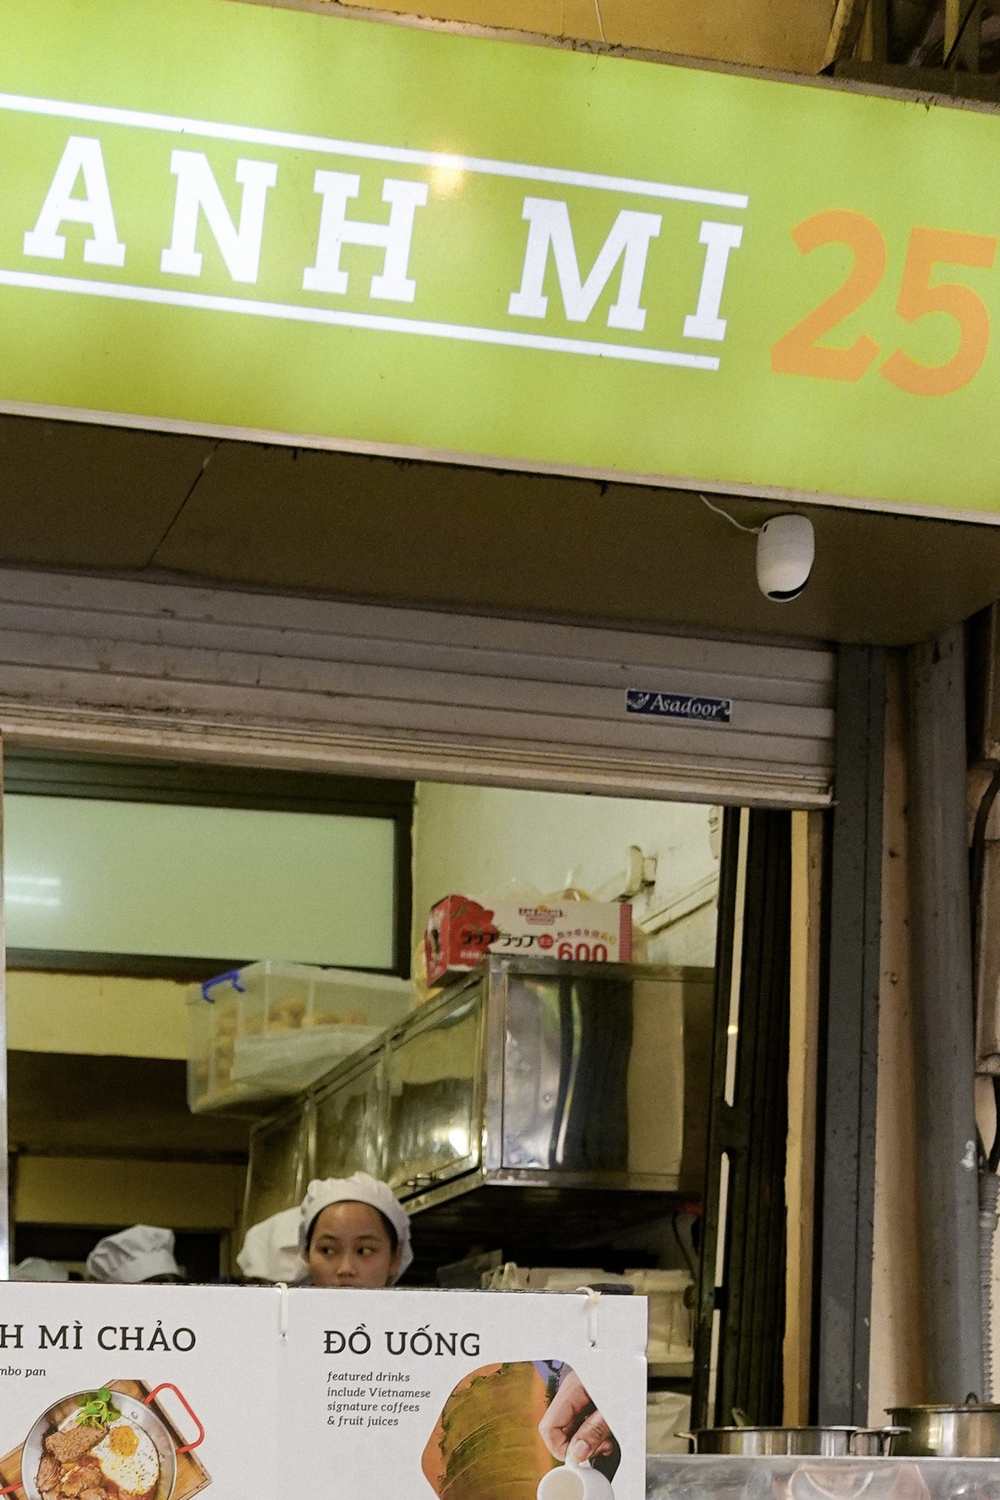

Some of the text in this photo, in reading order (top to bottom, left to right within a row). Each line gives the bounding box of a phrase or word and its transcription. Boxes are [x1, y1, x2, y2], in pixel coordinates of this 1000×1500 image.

[508, 196, 743, 341] MI
[769, 208, 997, 396] 25
[650, 695, 721, 716] Asadoor
[558, 942, 607, 961] 600
[38, 1320, 83, 1350] MÌ
[98, 1320, 196, 1352] CHẢO
[324, 1323, 480, 1356] ĐỒ UỐNG
[25, 1369, 46, 1378] pan
[327, 1371, 410, 1382] featured drinks
[327, 1387, 431, 1398] include Vietnamese
[327, 1401, 419, 1413] signature coffees
[327, 1416, 398, 1427] & fruit juices
